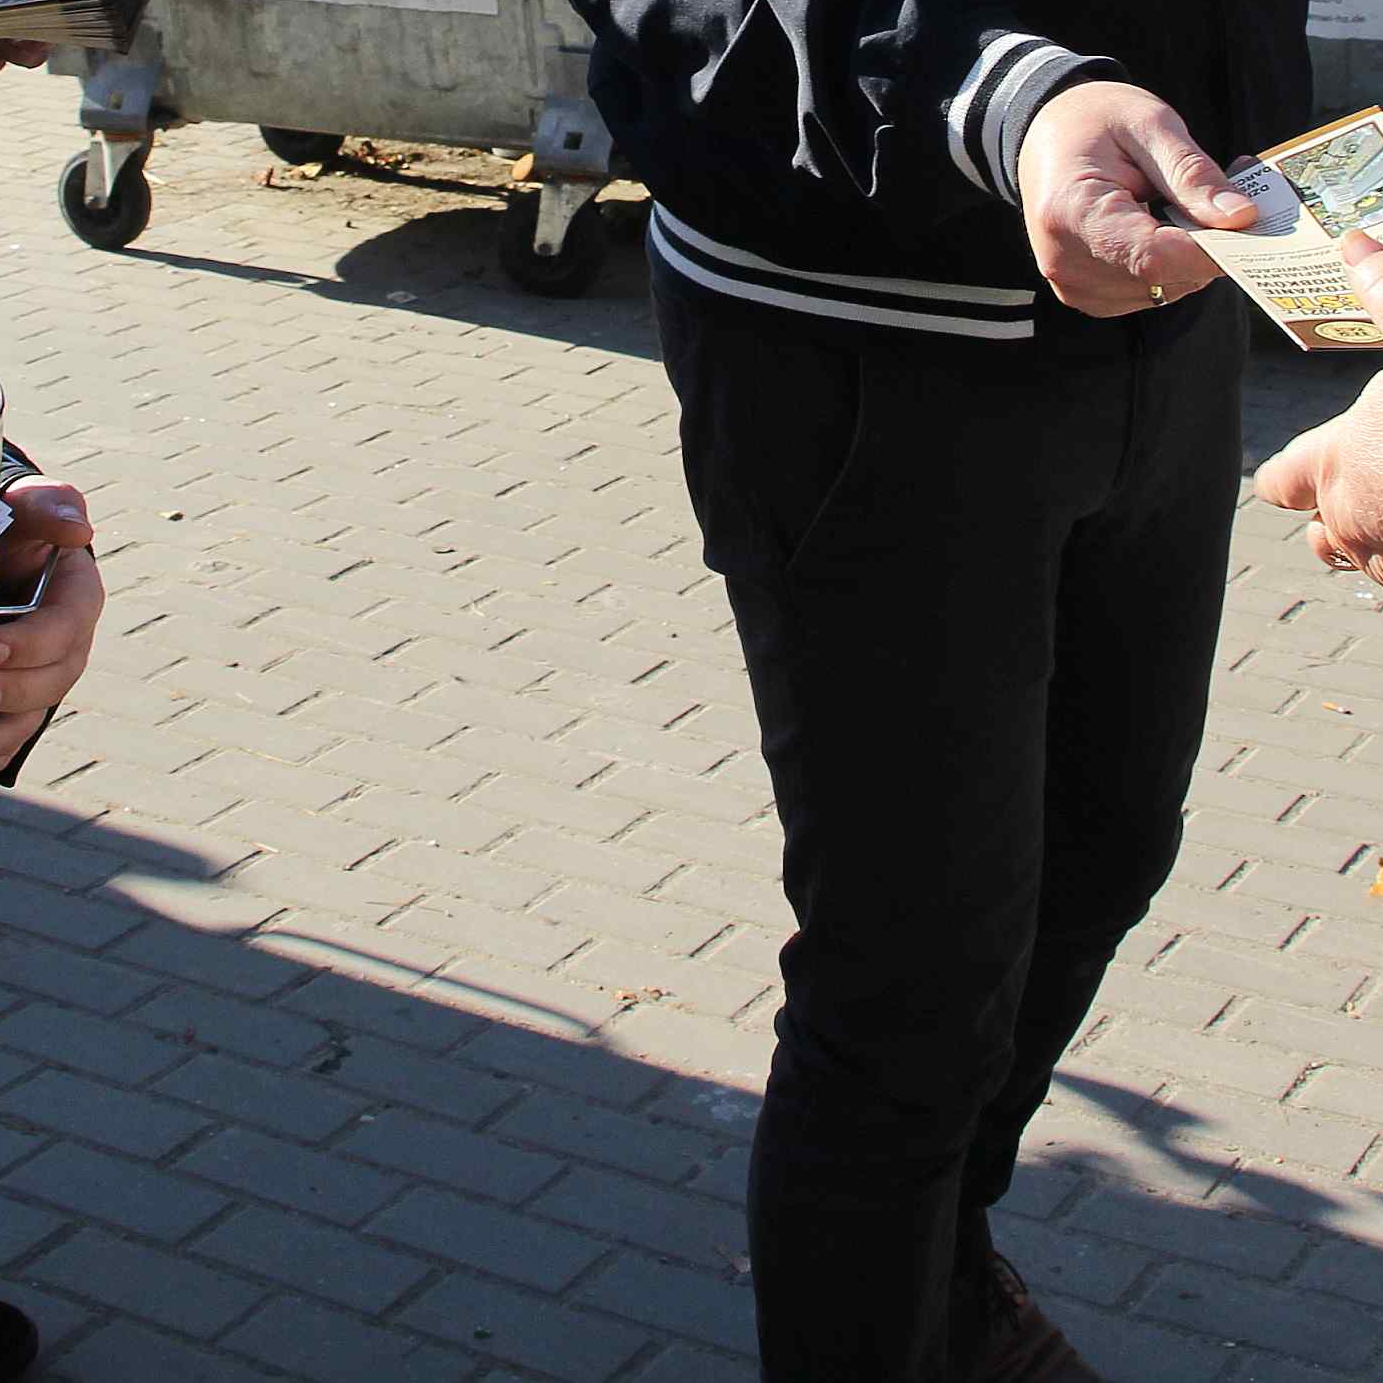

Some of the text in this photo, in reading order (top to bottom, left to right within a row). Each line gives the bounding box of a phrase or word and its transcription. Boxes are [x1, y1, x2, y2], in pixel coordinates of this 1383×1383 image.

[1232, 166, 1272, 189] DARC
[1247, 184, 1271, 198] DZI
[1242, 261, 1342, 274] OŚNIEWICACH
[1247, 267, 1341, 279] ARAFIALNYM
[1267, 285, 1351, 296] TOWANIE
[1266, 292, 1358, 310] ESTA
